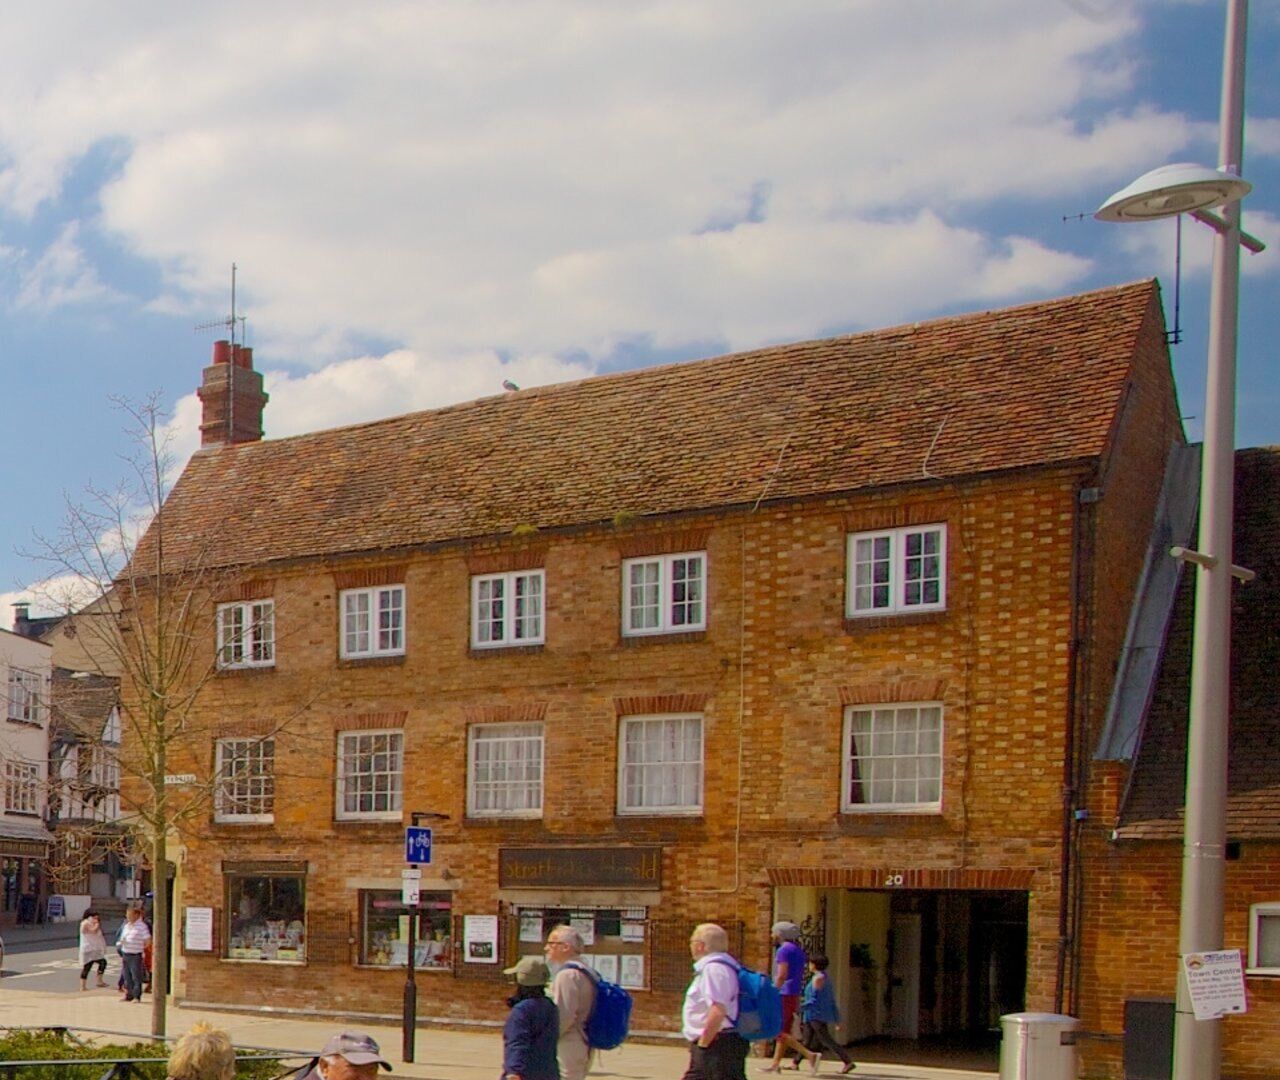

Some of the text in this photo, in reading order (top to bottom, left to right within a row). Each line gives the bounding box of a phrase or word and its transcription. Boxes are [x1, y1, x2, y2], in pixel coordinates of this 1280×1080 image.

[884, 874, 904, 886] 20
[1188, 967, 1242, 978] Town Centre
